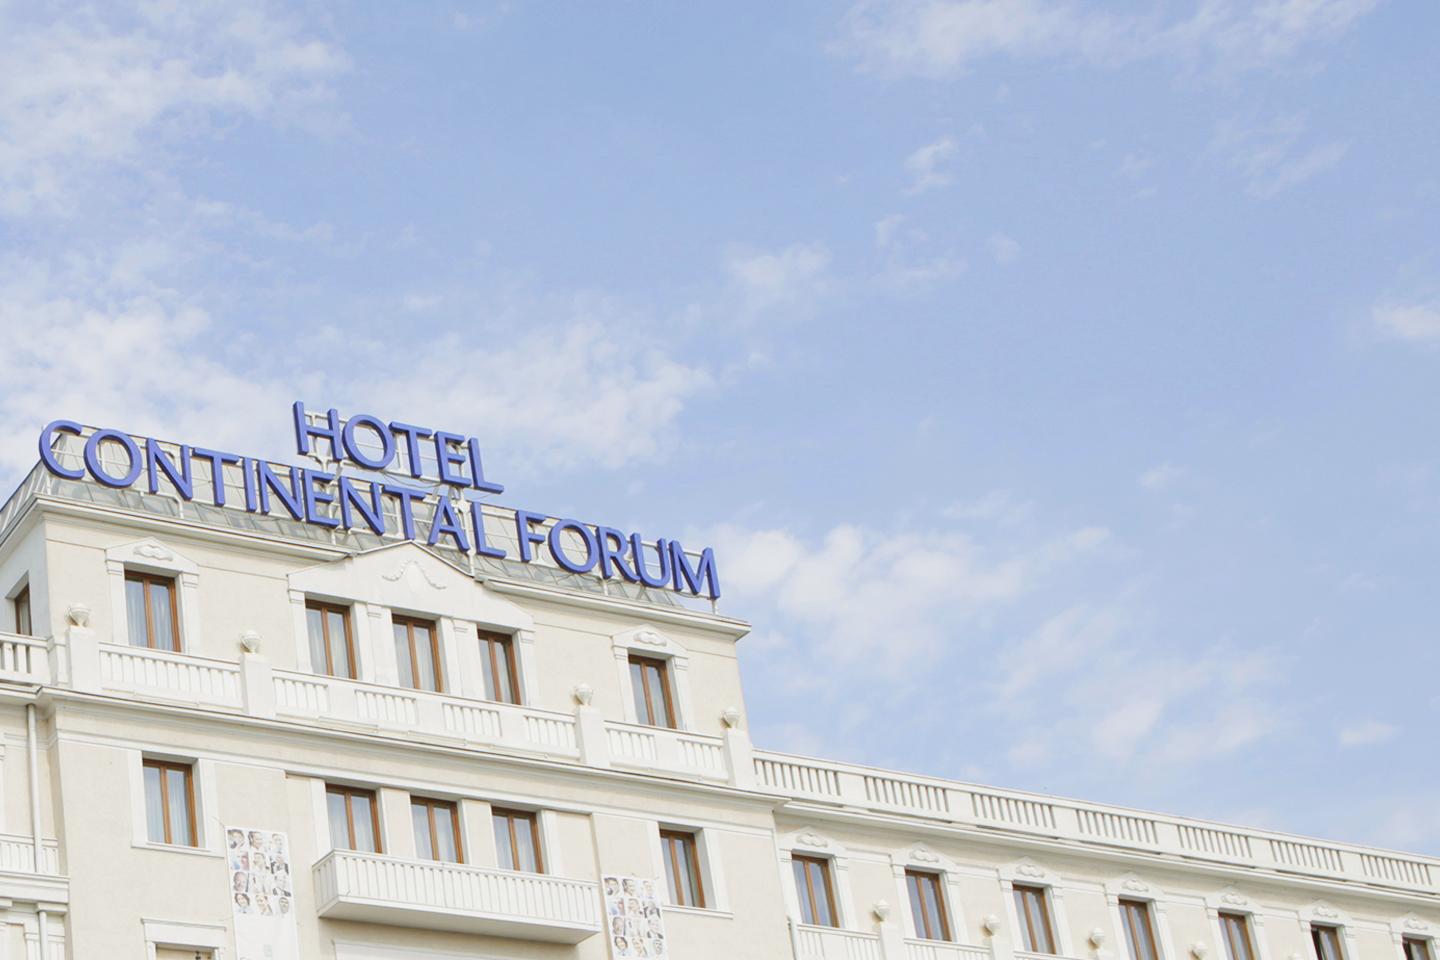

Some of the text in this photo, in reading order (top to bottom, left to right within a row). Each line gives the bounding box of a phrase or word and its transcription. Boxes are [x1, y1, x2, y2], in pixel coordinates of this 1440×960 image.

[39, 419, 721, 600] CONTINENTAL FORUM
[293, 401, 504, 494] HOTEL
